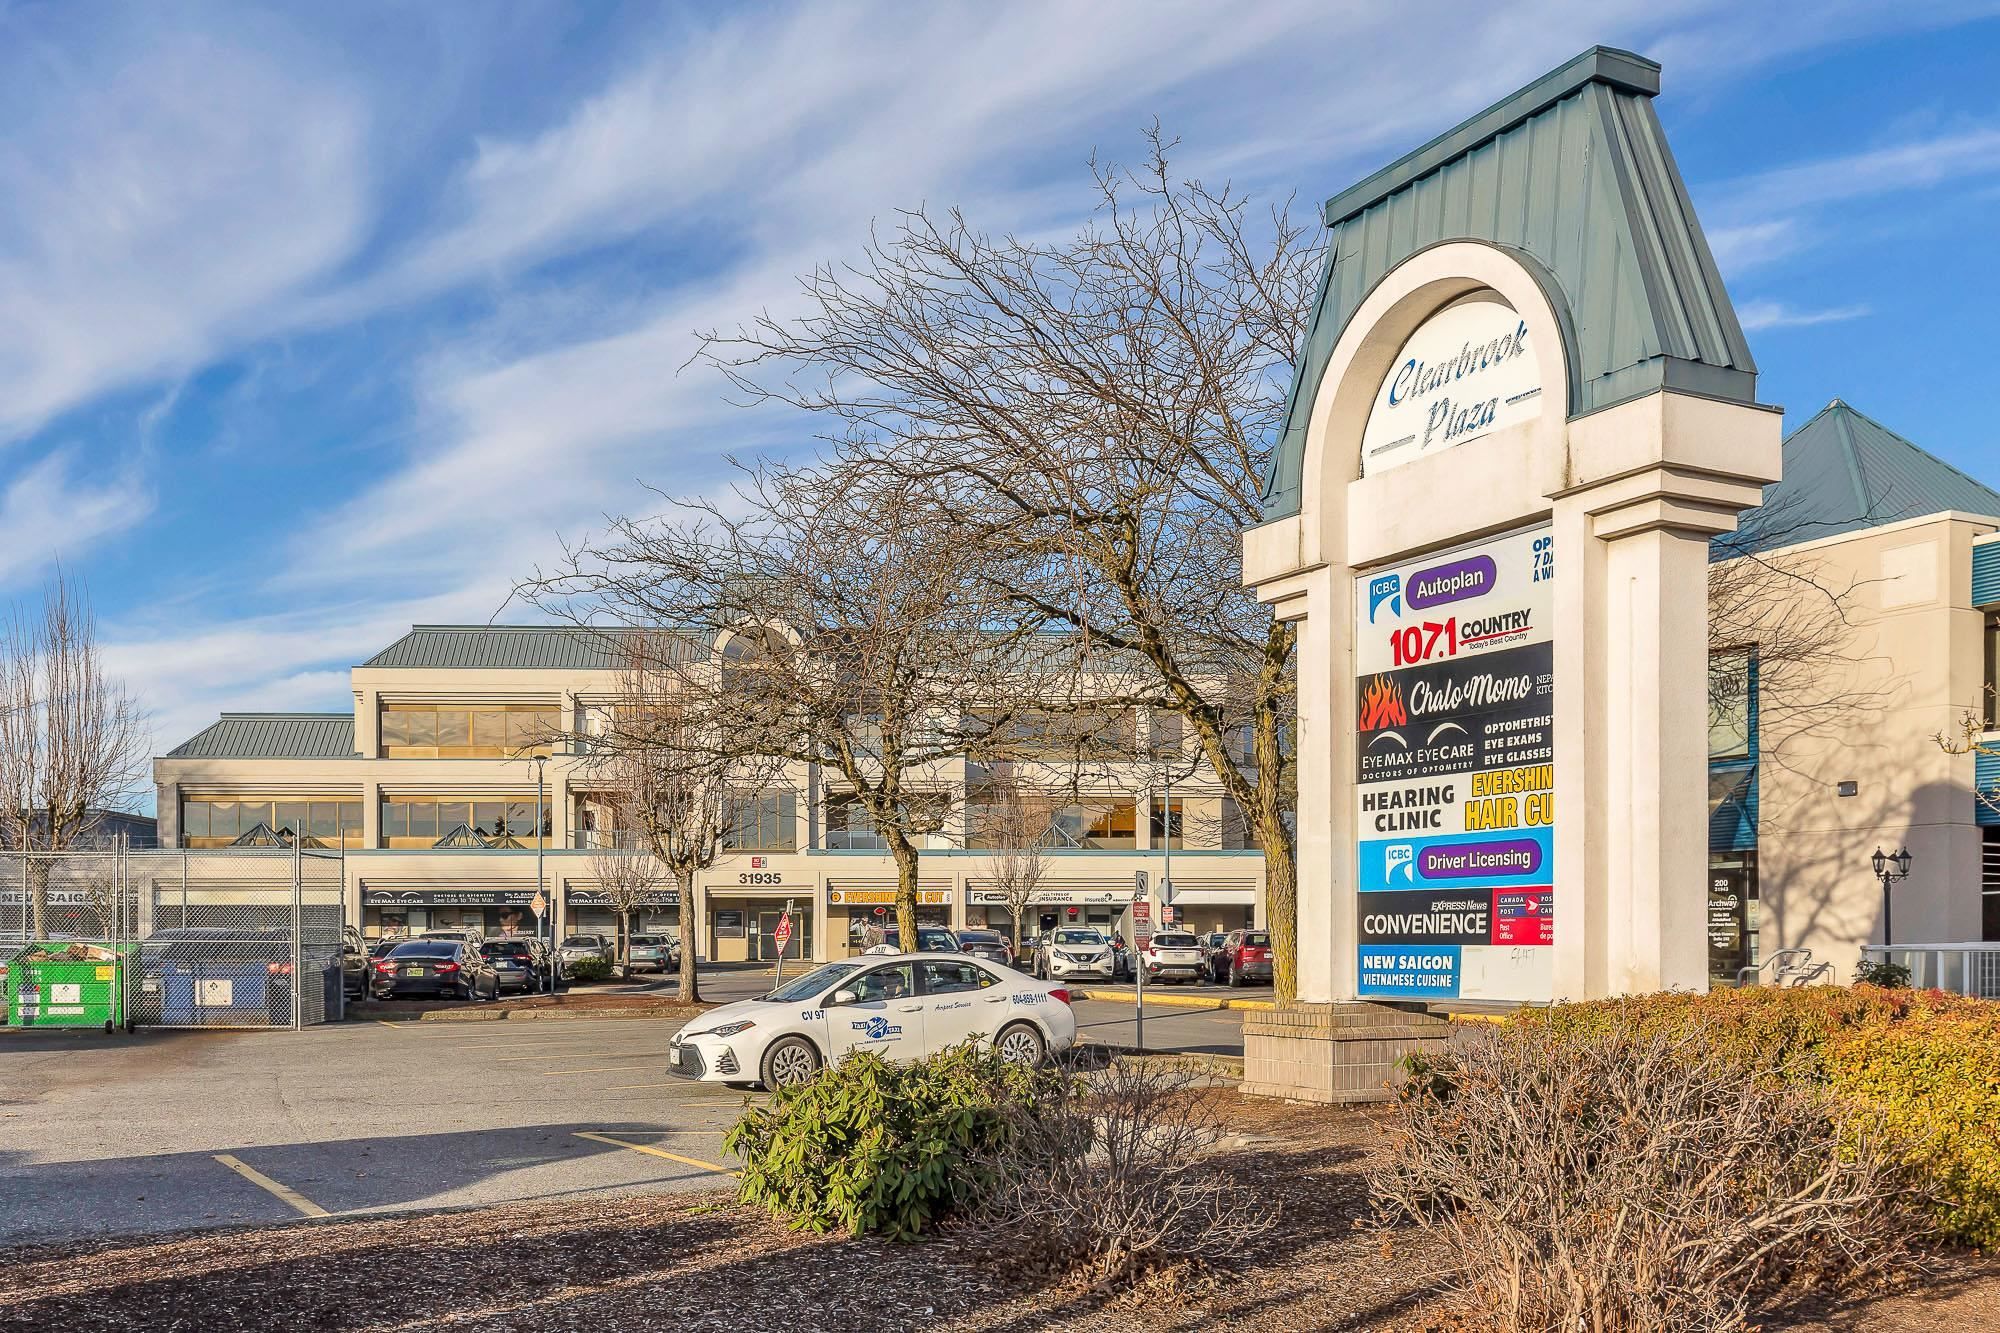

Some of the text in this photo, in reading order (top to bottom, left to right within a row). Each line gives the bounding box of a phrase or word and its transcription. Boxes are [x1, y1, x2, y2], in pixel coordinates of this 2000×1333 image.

[1388, 320, 1528, 407] Clearbrook
[1421, 397, 1499, 448] Plaza
[1533, 536, 1553, 552] OP
[1534, 553, 1541, 568] 7
[1534, 565, 1553, 582] A W
[1372, 579, 1397, 596] ICBC
[1416, 569, 1484, 599] Autoplan
[1390, 608, 1532, 666] 107.1 COUNTRY
[1468, 632, 1528, 650] Today's Best Country
[1409, 673, 1532, 716] Chalo Momo
[1484, 732, 1542, 750] EYE EXAMS
[1417, 744, 1474, 763] EYECARE
[1484, 746, 1552, 766] EYE GLASSES
[1362, 760, 1473, 780] DOCTORS OF OPTOMETRY
[1472, 764, 1553, 797] EVERSHIN
[1362, 785, 1455, 811] HEARING
[1465, 792, 1553, 831] HAIR CU
[1374, 809, 1442, 832] CLINIC
[1388, 849, 1410, 860] ICBC
[1428, 849, 1531, 870] Driver Licensing
[739, 873, 782, 884] 31935
[1714, 879, 1728, 887] 200
[924, 891, 944, 903] CUT
[1431, 900, 1487, 911] EXPRESS News
[1708, 899, 1737, 909] Archway
[1363, 913, 1487, 934] CONVENIENCE
[1499, 923, 1510, 931] Post
[1499, 931, 1514, 940] Office
[1363, 955, 1453, 970] NEW SAIGON
[1363, 973, 1452, 987] VIETNAMESE CUISINE
[802, 1009, 825, 1020] CV 97
[934, 1001, 971, 1011] Airport Service
